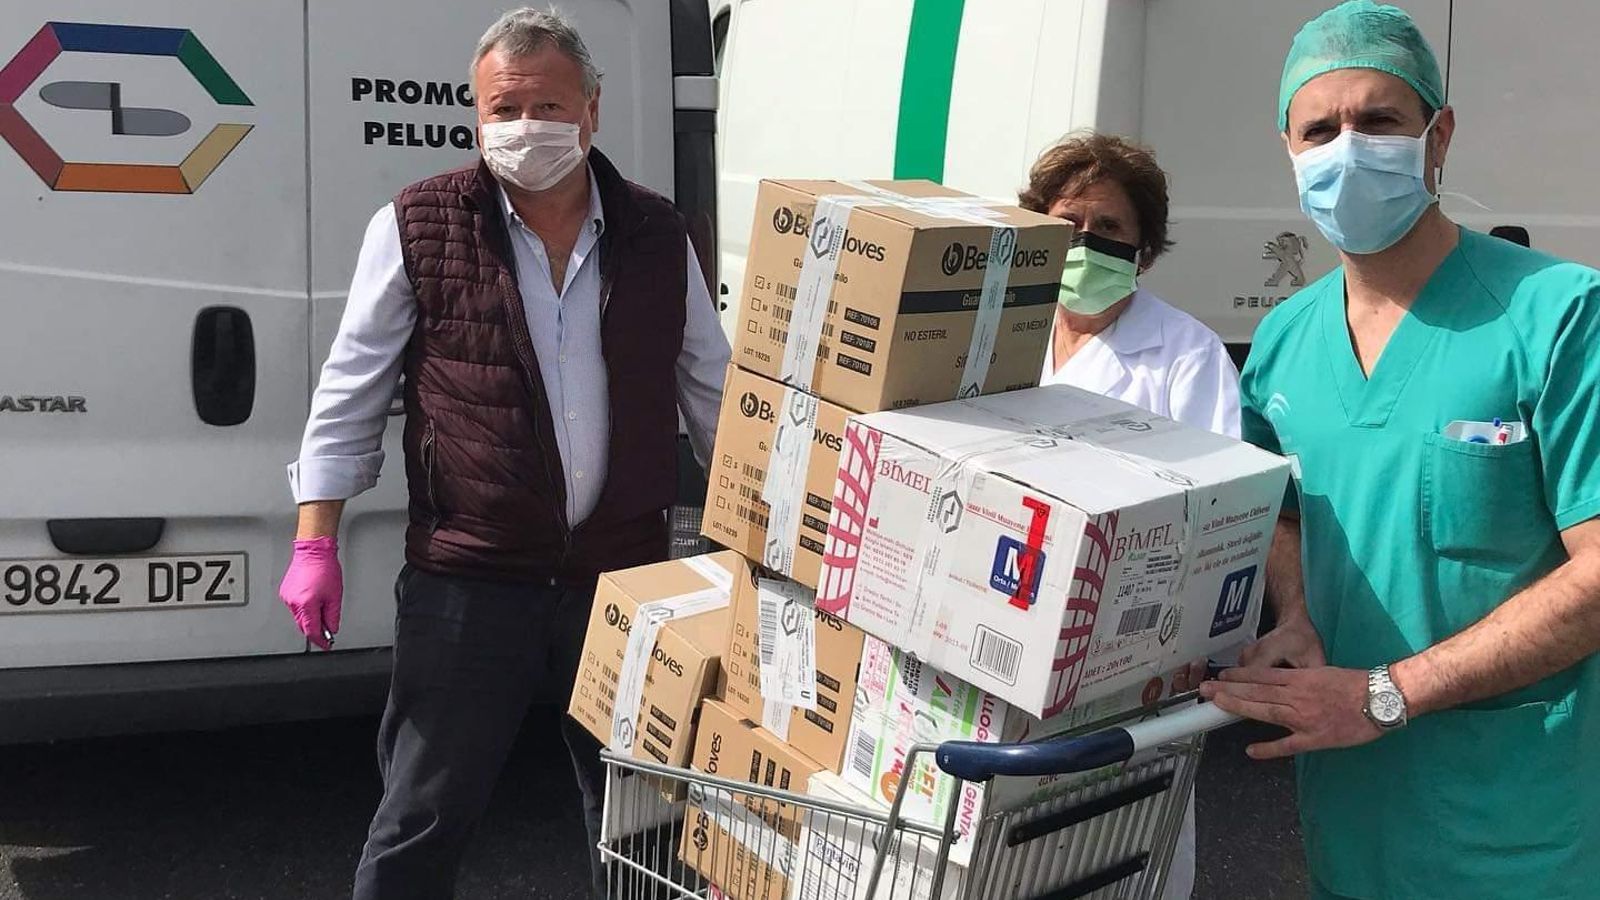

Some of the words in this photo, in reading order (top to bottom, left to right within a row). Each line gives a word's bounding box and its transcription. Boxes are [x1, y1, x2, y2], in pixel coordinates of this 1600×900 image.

[363, 121, 474, 151] PELUQ
[841, 228, 887, 262] loves
[1010, 244, 1050, 269] loves
[904, 330, 917, 342] NO
[1012, 320, 1025, 333] USO
[0, 395, 88, 413] ASTAR
[4, 562, 121, 606] 9842
[148, 560, 232, 603] DPZ
[1222, 575, 1249, 616] M
[650, 640, 685, 678] loves
[704, 732, 722, 774] loves
[958, 785, 978, 838] GENTA
